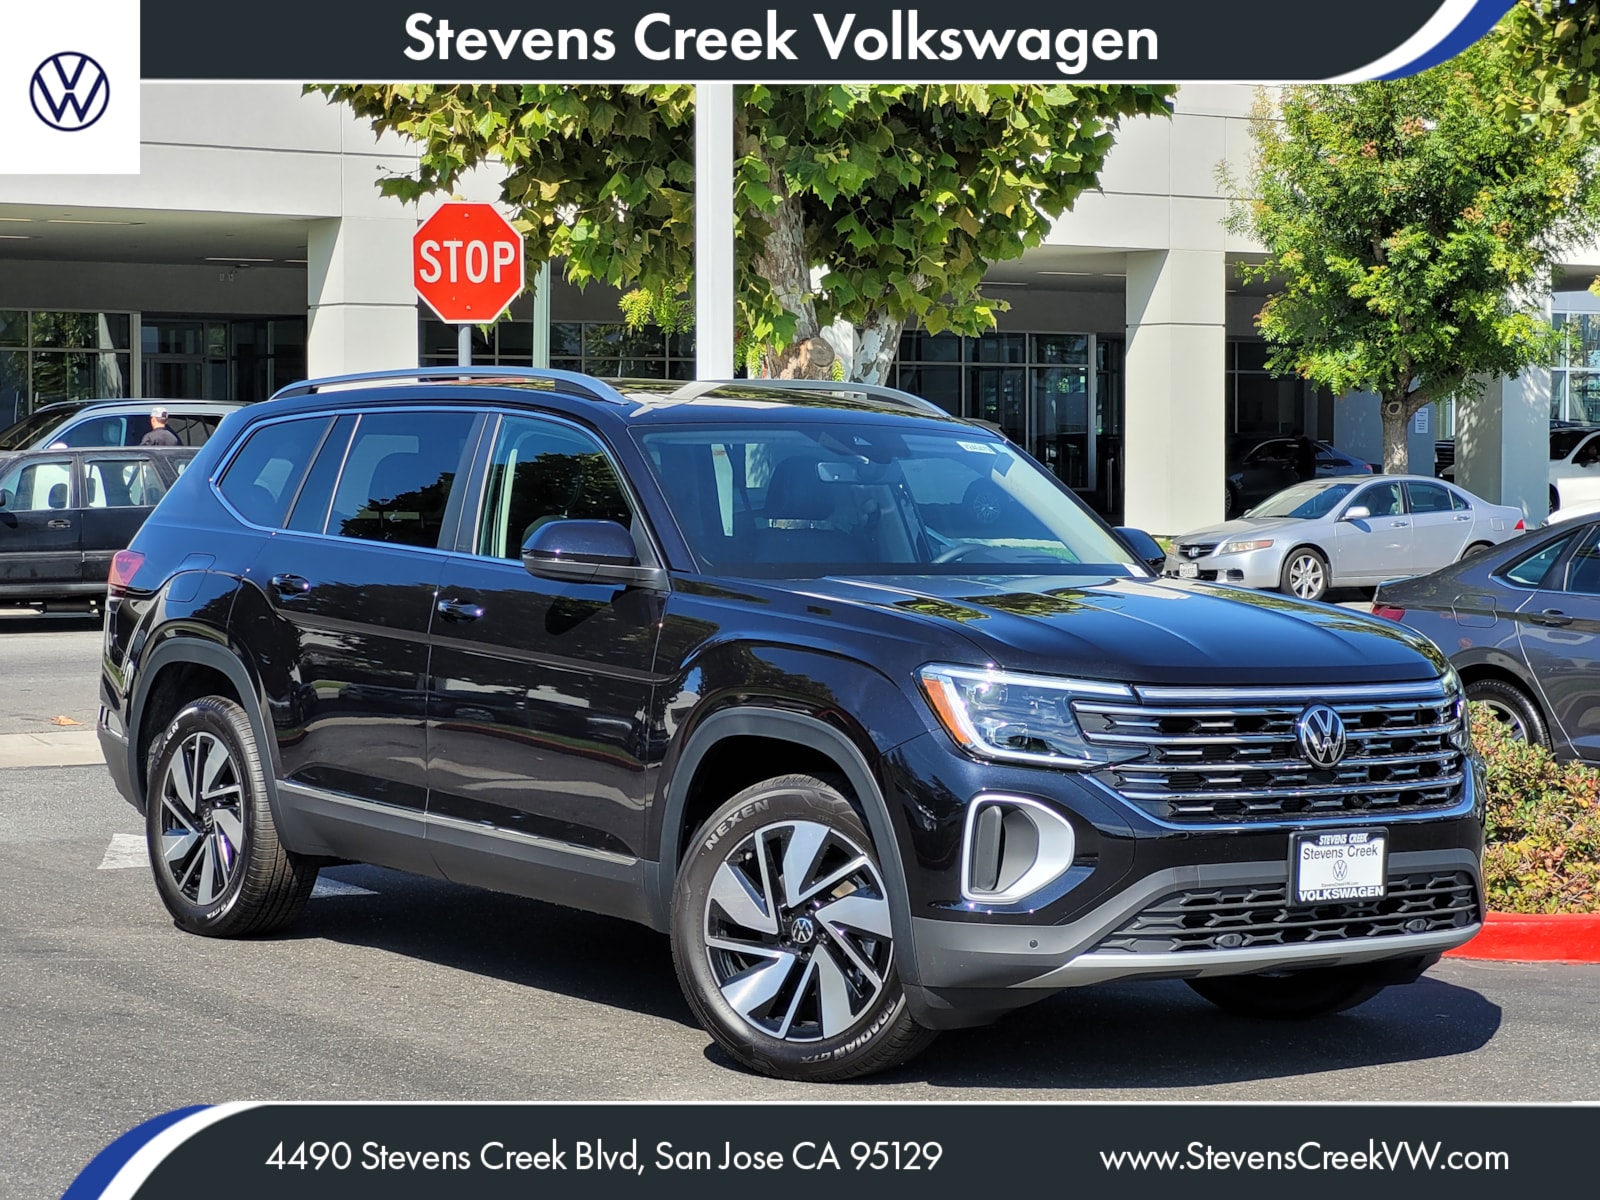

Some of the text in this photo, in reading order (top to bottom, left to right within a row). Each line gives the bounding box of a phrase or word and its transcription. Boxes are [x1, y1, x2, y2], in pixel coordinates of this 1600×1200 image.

[419, 240, 515, 284] STOP
[705, 799, 769, 851] NEXEN
[1318, 832, 1369, 846] STEVENS CREEK
[1303, 844, 1378, 860] Stevens Creek
[1299, 886, 1384, 901] VOLKSWAGEN
[800, 998, 896, 1064] ROADIAN GTX
